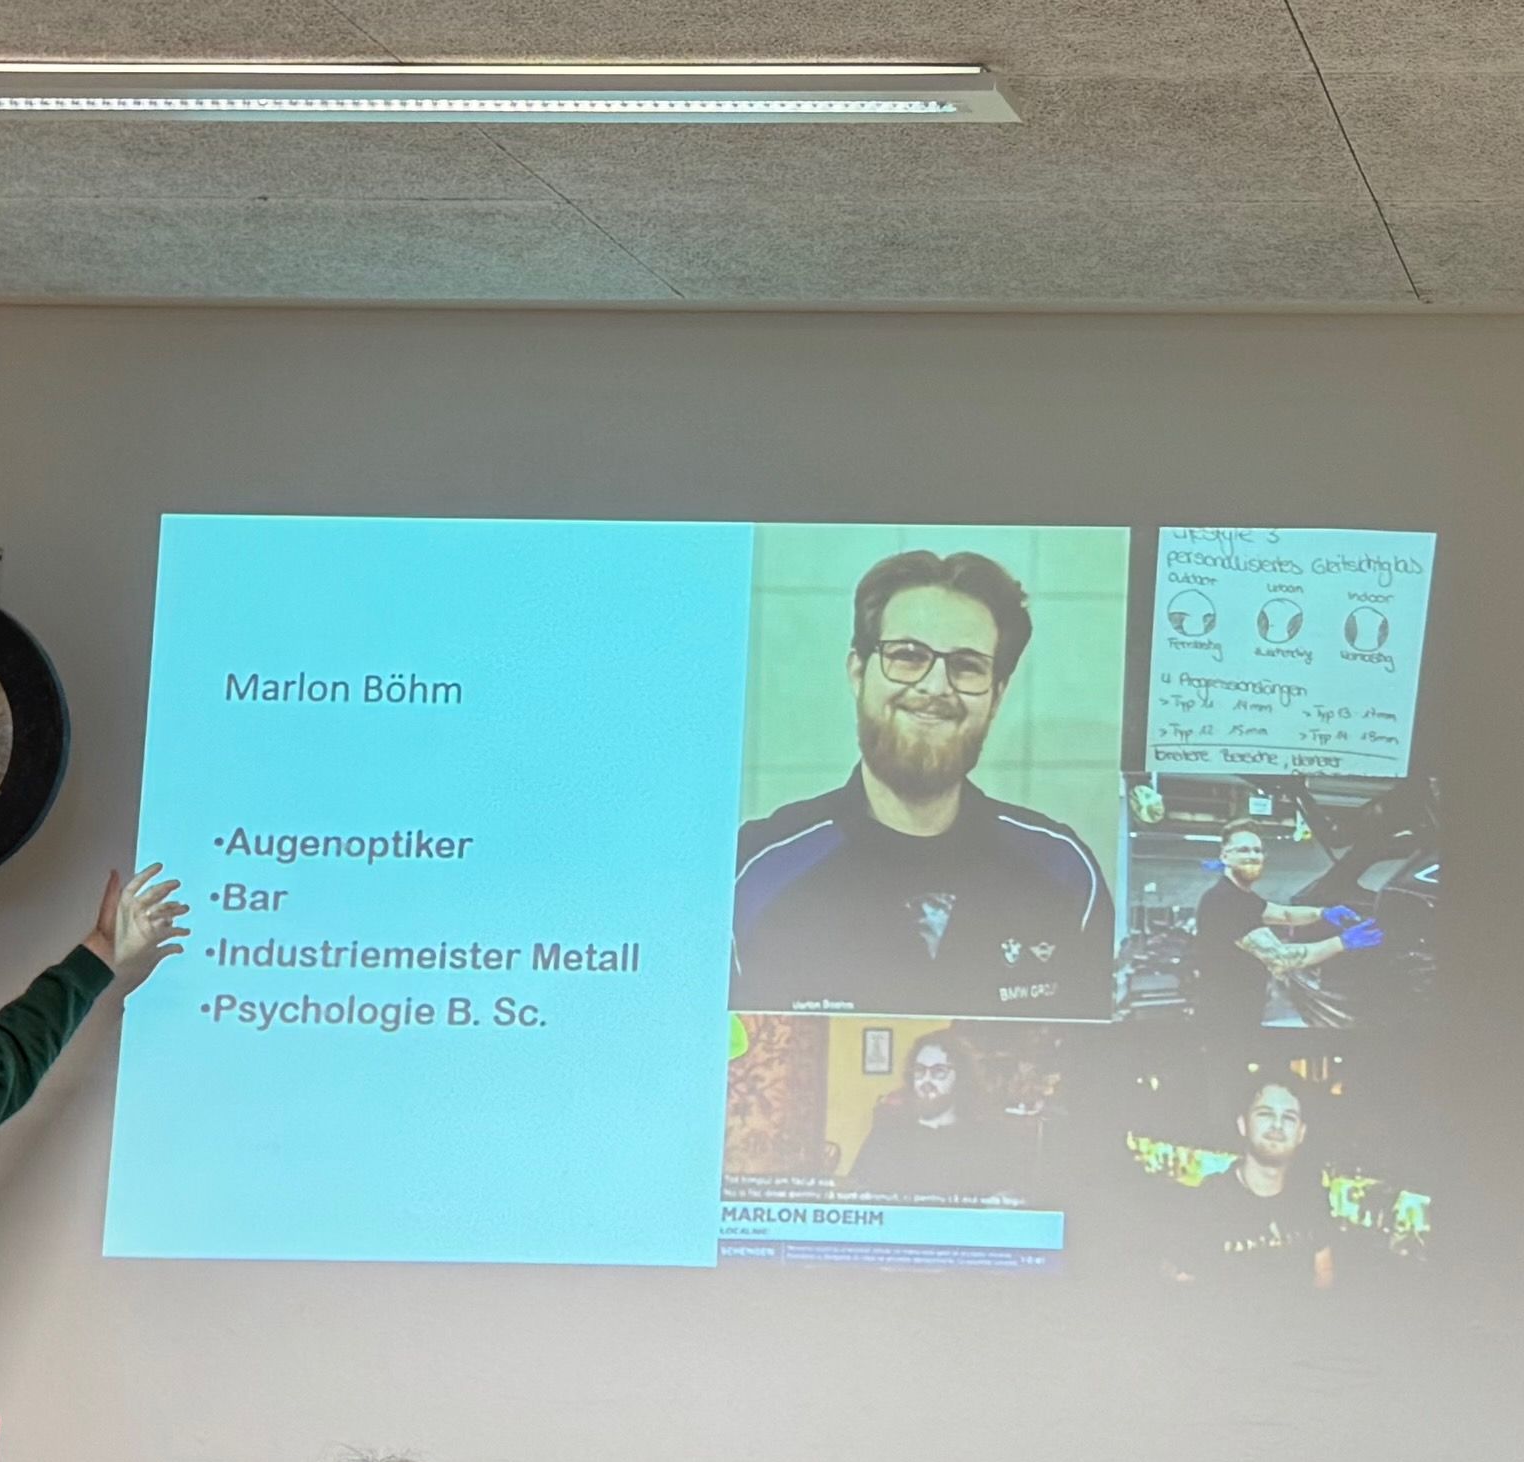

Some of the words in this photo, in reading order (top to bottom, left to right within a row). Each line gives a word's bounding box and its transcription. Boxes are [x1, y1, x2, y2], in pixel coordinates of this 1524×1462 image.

[225, 671, 350, 702] Marlon
[363, 673, 463, 704] Böhm
[225, 826, 474, 865] Augenoptiker
[222, 882, 289, 912] Bar
[217, 938, 522, 970] Industriemeister
[532, 942, 640, 972] Metall
[213, 994, 436, 1032] Psychologie
[446, 997, 480, 1027] B.
[493, 997, 547, 1027] Sc.
[721, 1206, 808, 1223] MARLON
[812, 1208, 885, 1226] BOEHM
